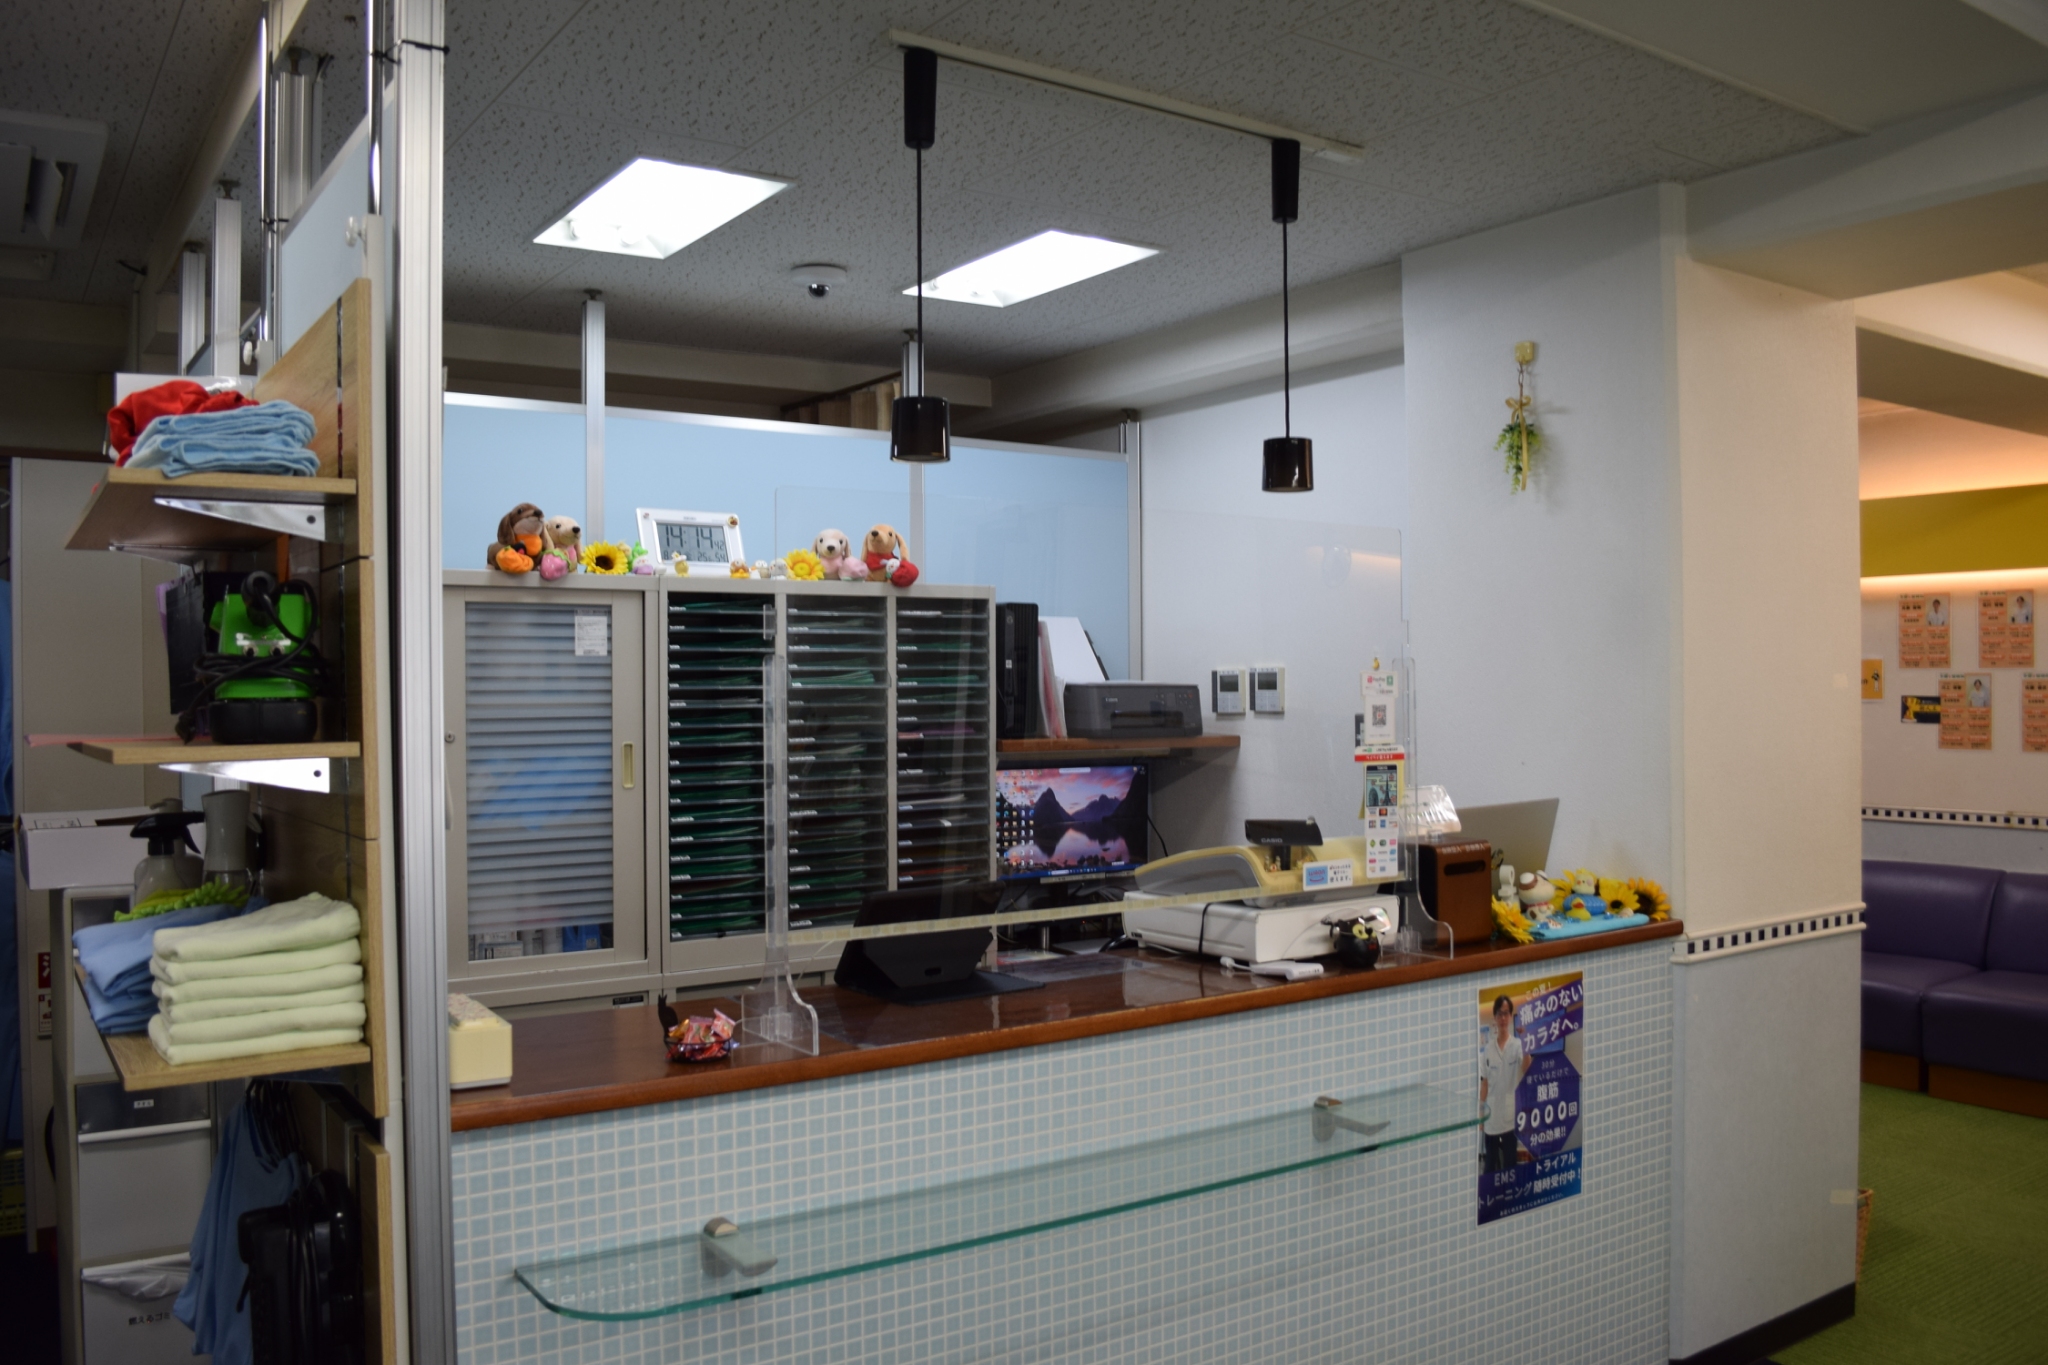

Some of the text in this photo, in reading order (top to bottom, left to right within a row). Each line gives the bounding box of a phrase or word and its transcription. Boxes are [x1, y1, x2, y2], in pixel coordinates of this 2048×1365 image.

[665, 524, 714, 549] 14:14
[1520, 984, 1584, 1026] 痛みのない
[1524, 1018, 1580, 1052] カラダへ。
[1537, 1081, 1559, 1102] 腹筋
[1535, 1152, 1577, 1176] トライアル
[1494, 1169, 1517, 1187] EMS
